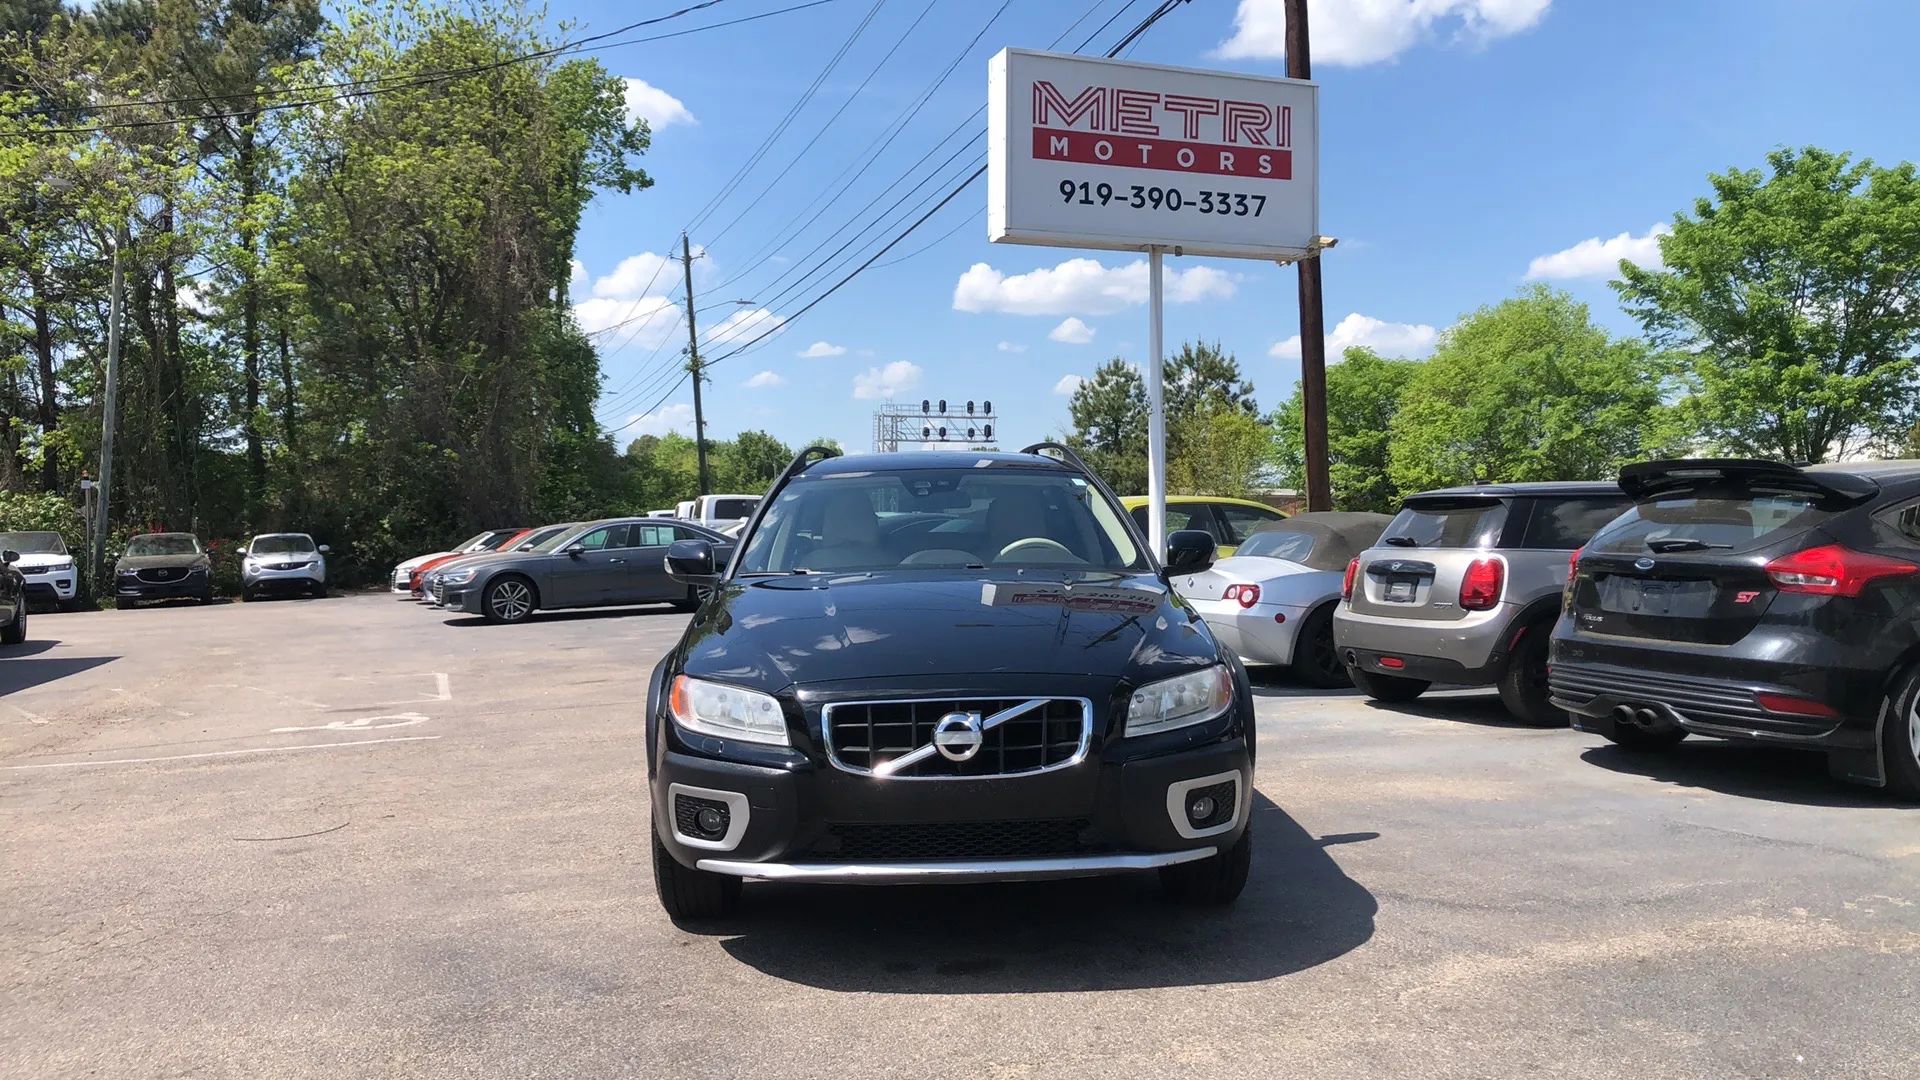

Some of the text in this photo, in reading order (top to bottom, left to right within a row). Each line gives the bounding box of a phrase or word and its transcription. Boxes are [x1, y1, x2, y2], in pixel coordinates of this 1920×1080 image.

[1033, 81, 1291, 147] METRI
[1050, 136, 1272, 173] MOTORS
[1060, 180, 1266, 217] 919-390-3337
[1734, 591, 1760, 603] ST
